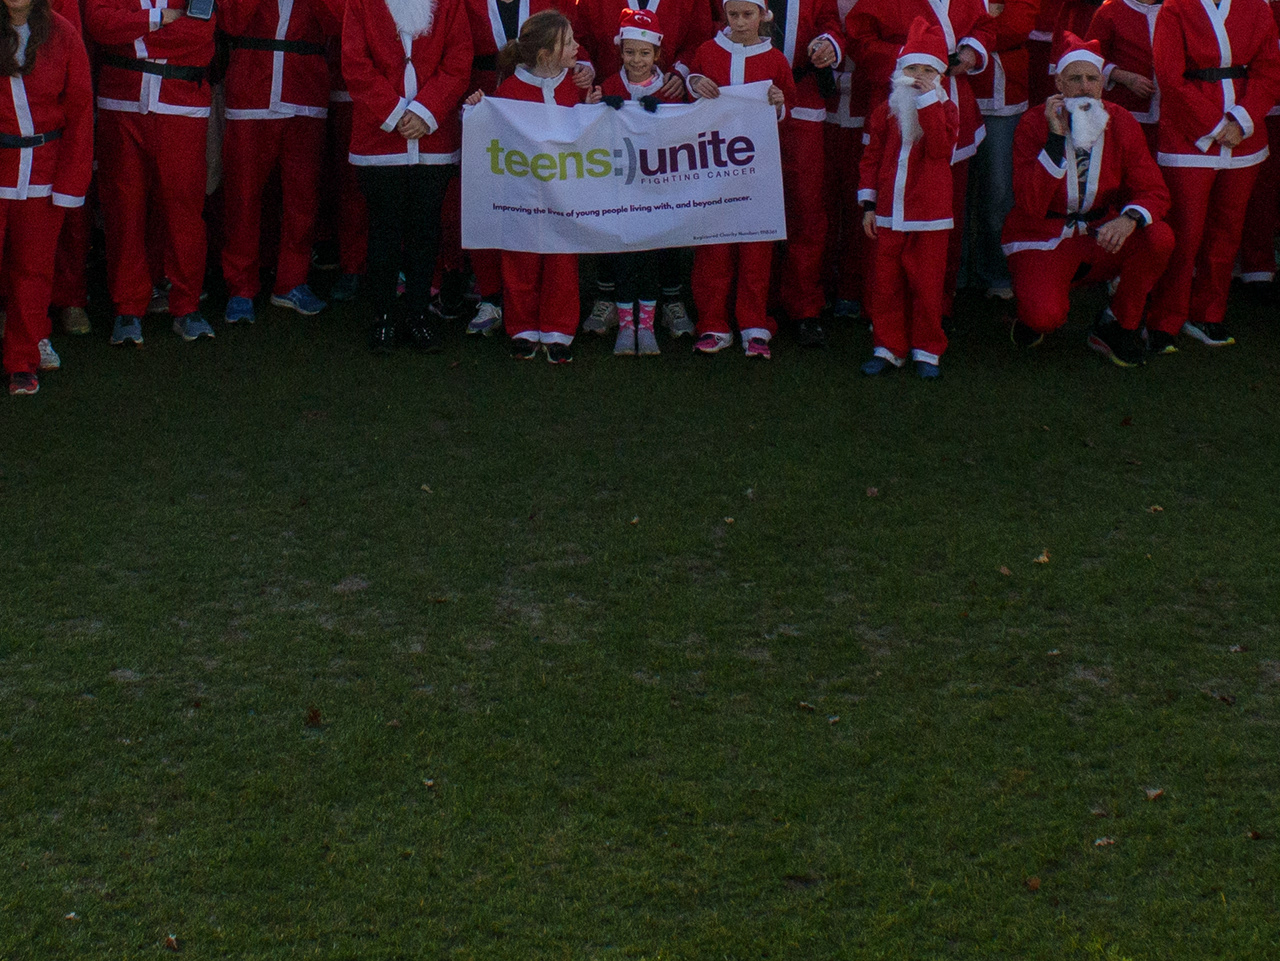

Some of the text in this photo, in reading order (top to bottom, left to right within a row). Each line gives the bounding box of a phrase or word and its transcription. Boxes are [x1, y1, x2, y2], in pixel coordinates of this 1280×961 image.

[641, 167, 756, 185] FIGHTING CANCER
[492, 202, 532, 215] Improving
[547, 207, 565, 217] lives
[565, 209, 575, 217] of
[575, 208, 600, 218] young
[601, 205, 628, 216] people
[629, 204, 652, 213] living
[653, 202, 674, 210] with,
[675, 200, 691, 209] and
[692, 197, 723, 208] beyond
[723, 195, 752, 204] cancer.
